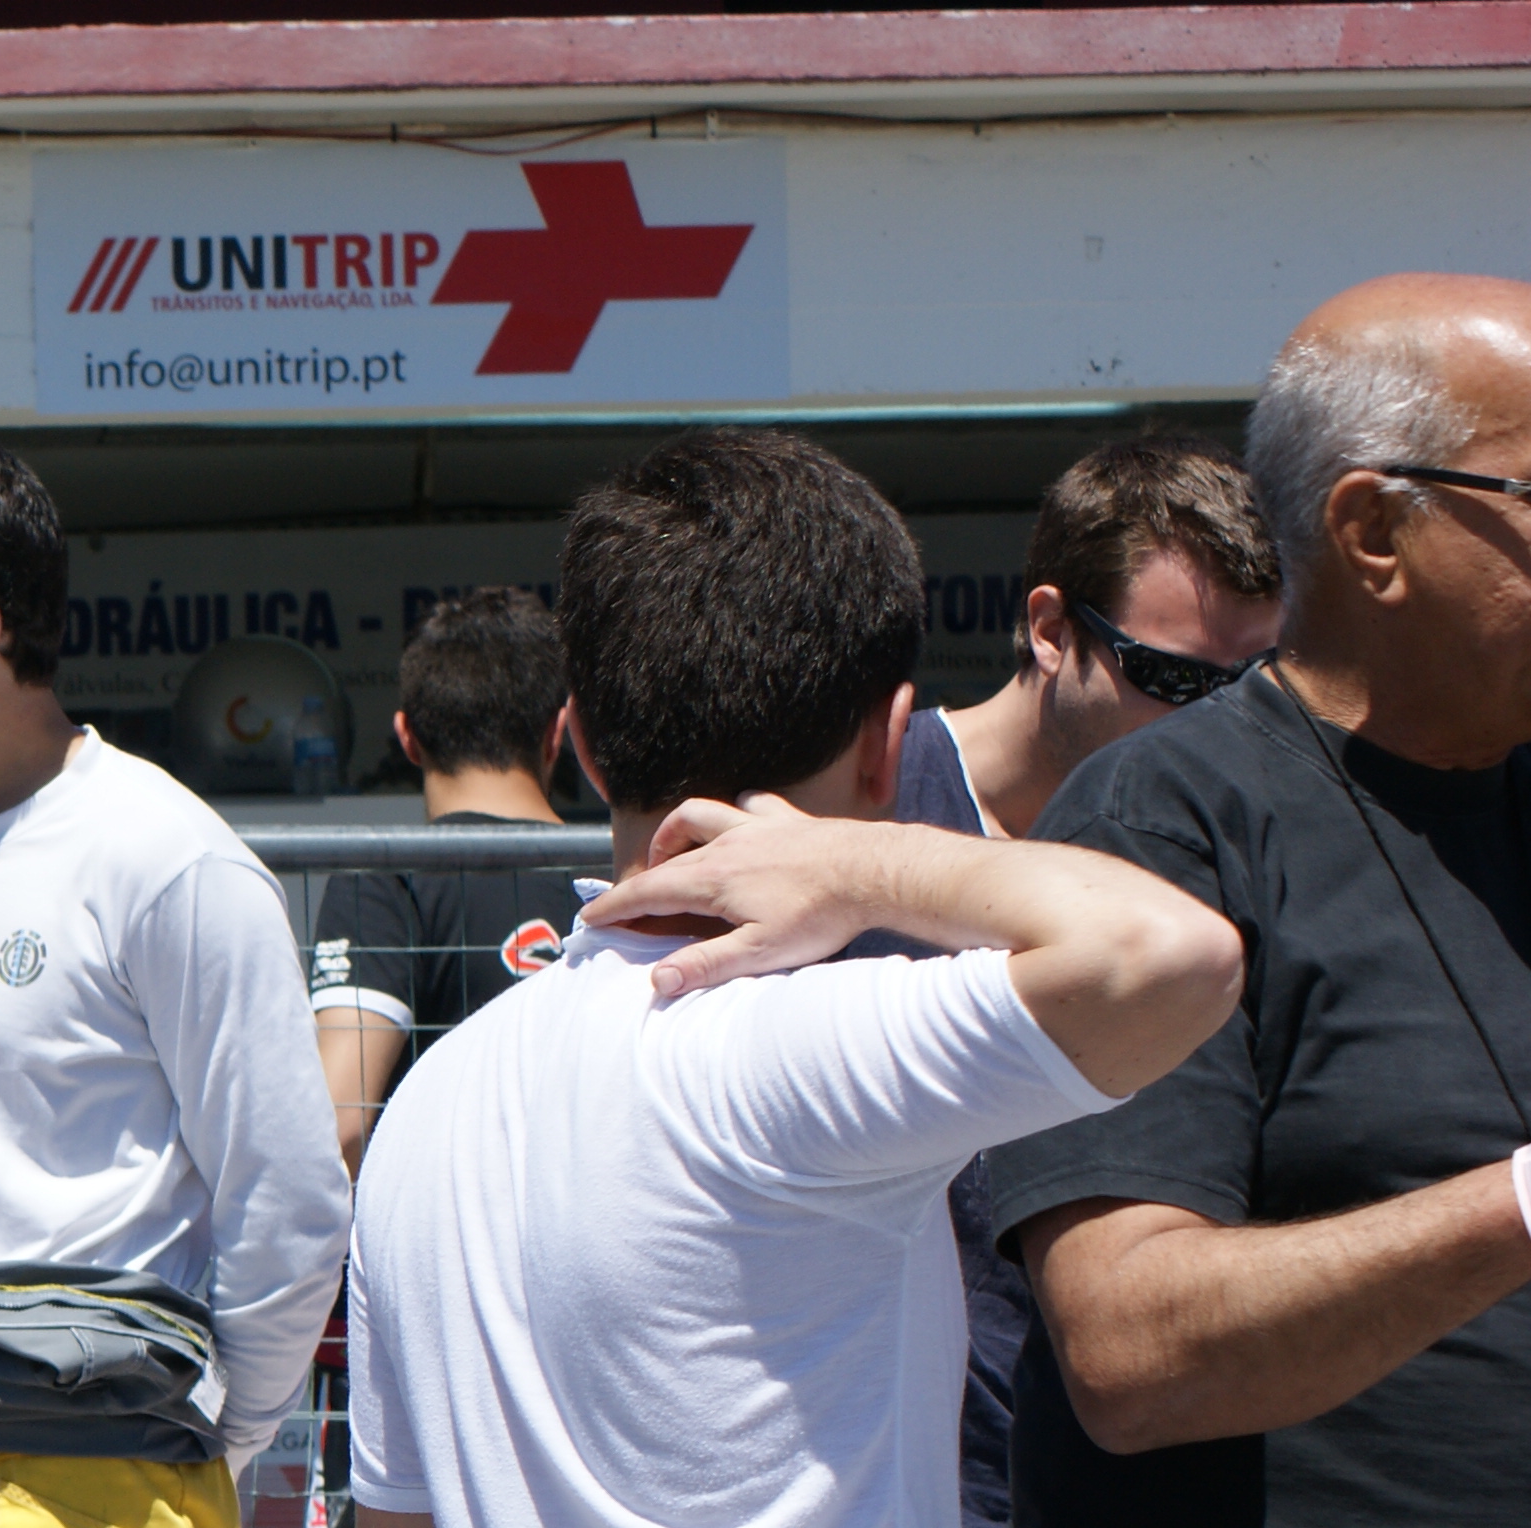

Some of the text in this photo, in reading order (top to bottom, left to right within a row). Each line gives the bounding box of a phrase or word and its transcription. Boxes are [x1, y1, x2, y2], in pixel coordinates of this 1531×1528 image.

[171, 232, 441, 292] UNITRIP
[151, 294, 245, 312] TRÂNSITOS
[250, 296, 260, 310] E
[380, 292, 417, 308] LDA.
[85, 348, 407, 393] info@unitrip.pt
